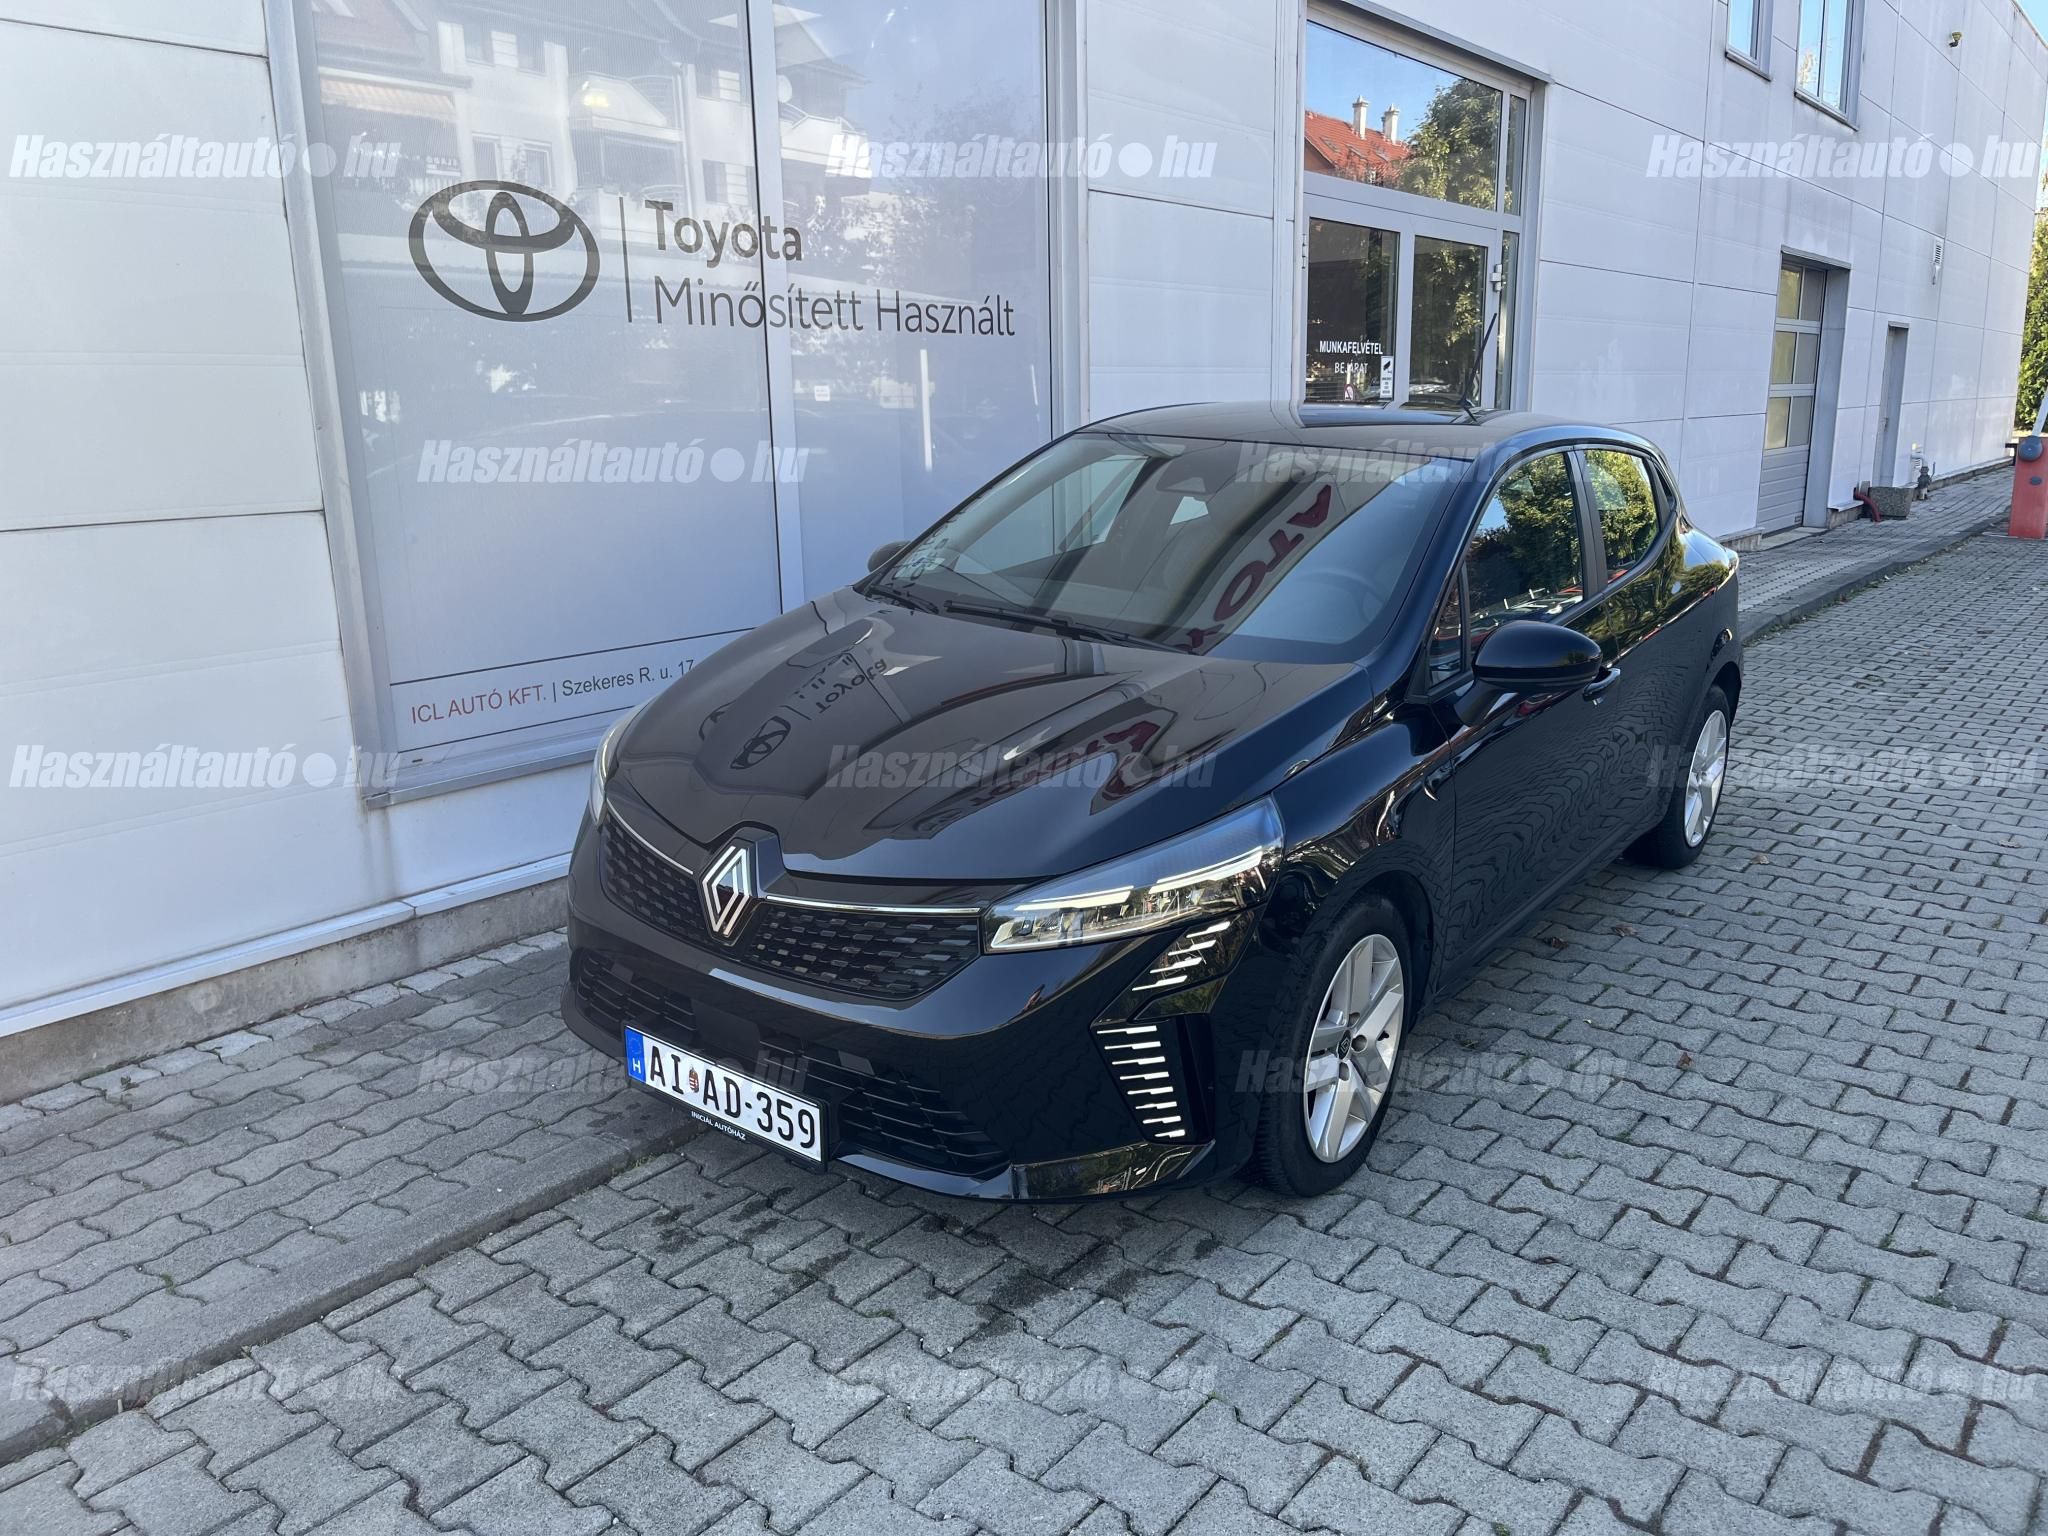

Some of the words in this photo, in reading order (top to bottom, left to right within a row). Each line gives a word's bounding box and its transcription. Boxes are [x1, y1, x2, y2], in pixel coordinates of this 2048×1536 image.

[645, 200, 801, 268] Toyota
[654, 275, 863, 331] Minősített
[876, 289, 1015, 337] Használt
[1319, 339, 1384, 355] MUNKAFELVÉTEL
[411, 702, 444, 724] ICL
[448, 690, 503, 719] AUTÓ
[508, 683, 547, 708] KFT.
[562, 671, 634, 697] Szekeres
[639, 666, 655, 683] R.
[659, 667, 673, 681] u.
